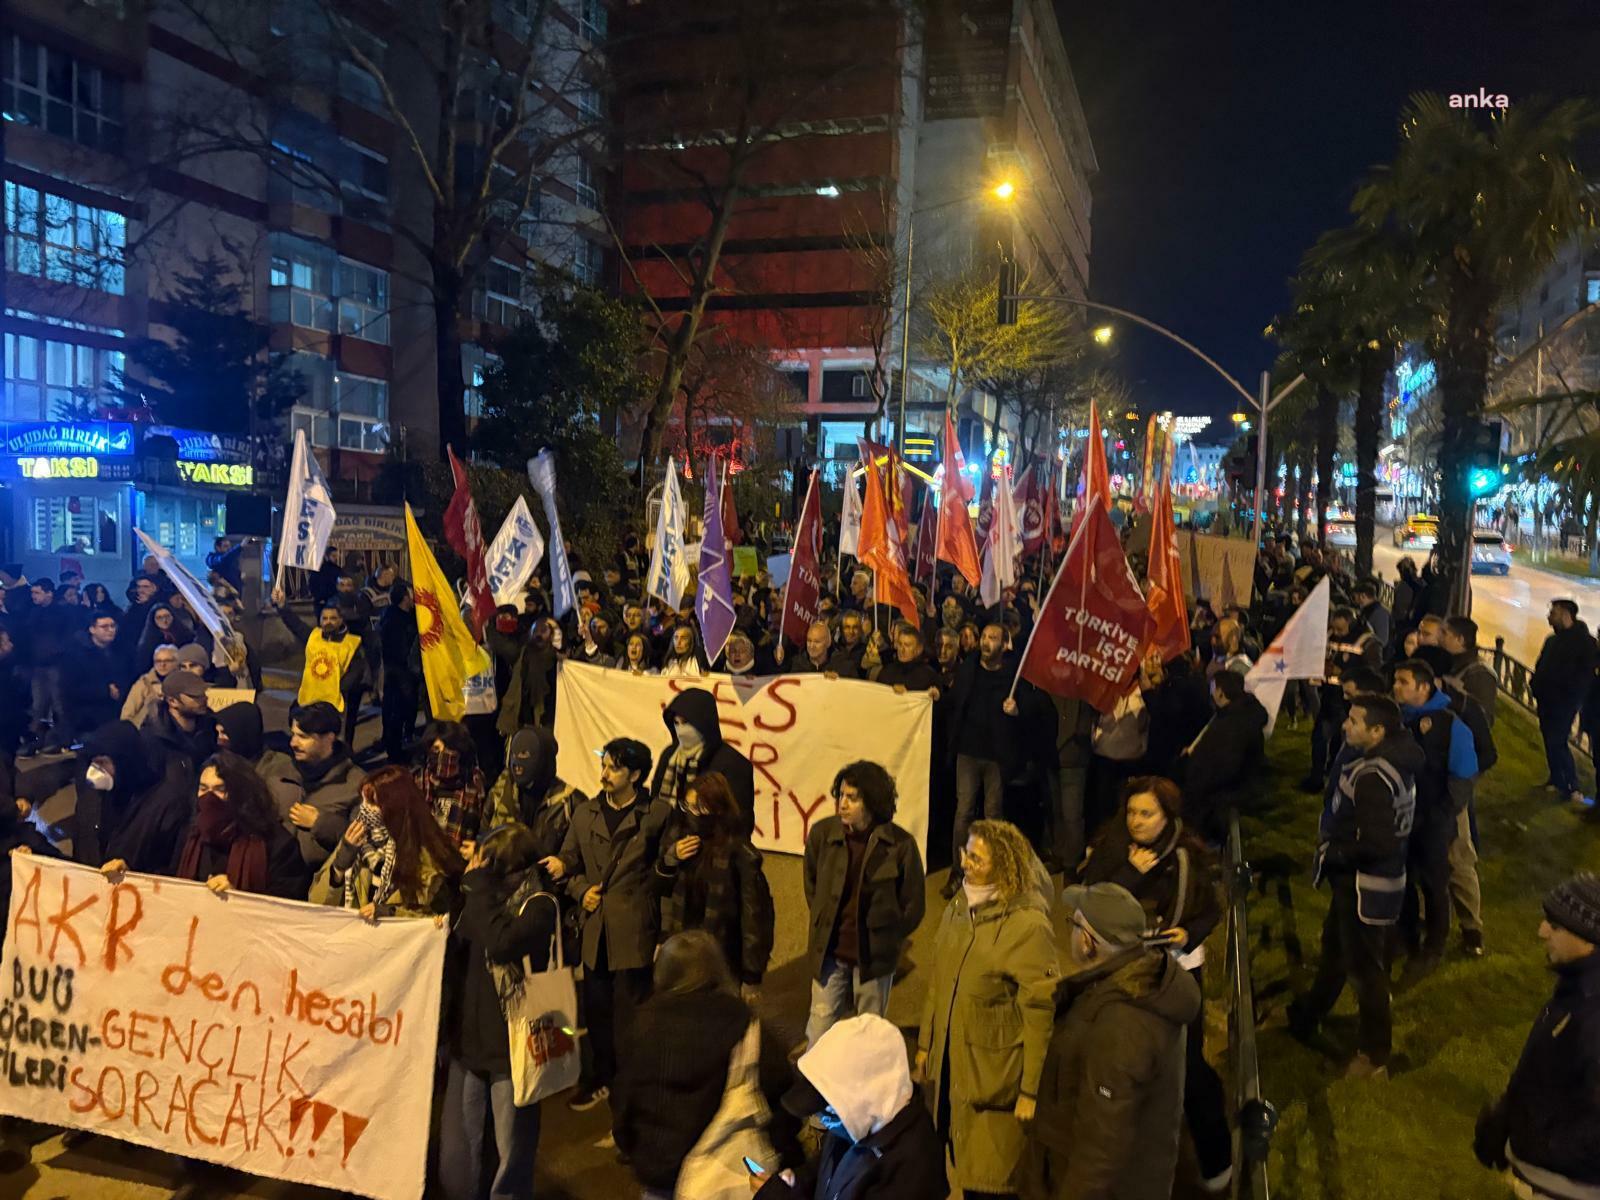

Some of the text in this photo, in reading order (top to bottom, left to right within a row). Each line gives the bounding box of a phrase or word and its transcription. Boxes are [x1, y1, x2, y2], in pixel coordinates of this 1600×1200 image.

[9, 424, 109, 452] ULUDAĞ BİRLİK
[1064, 605, 1139, 652] TÜRKİYE
[1096, 635, 1134, 665] İŞÇİ
[1056, 646, 1125, 684] PARTİSİ
[13, 956, 75, 1014] BUÜ
[160, 914, 261, 1017] den
[285, 967, 402, 1047] hesabı
[101, 1008, 309, 1101] GENÇLİK
